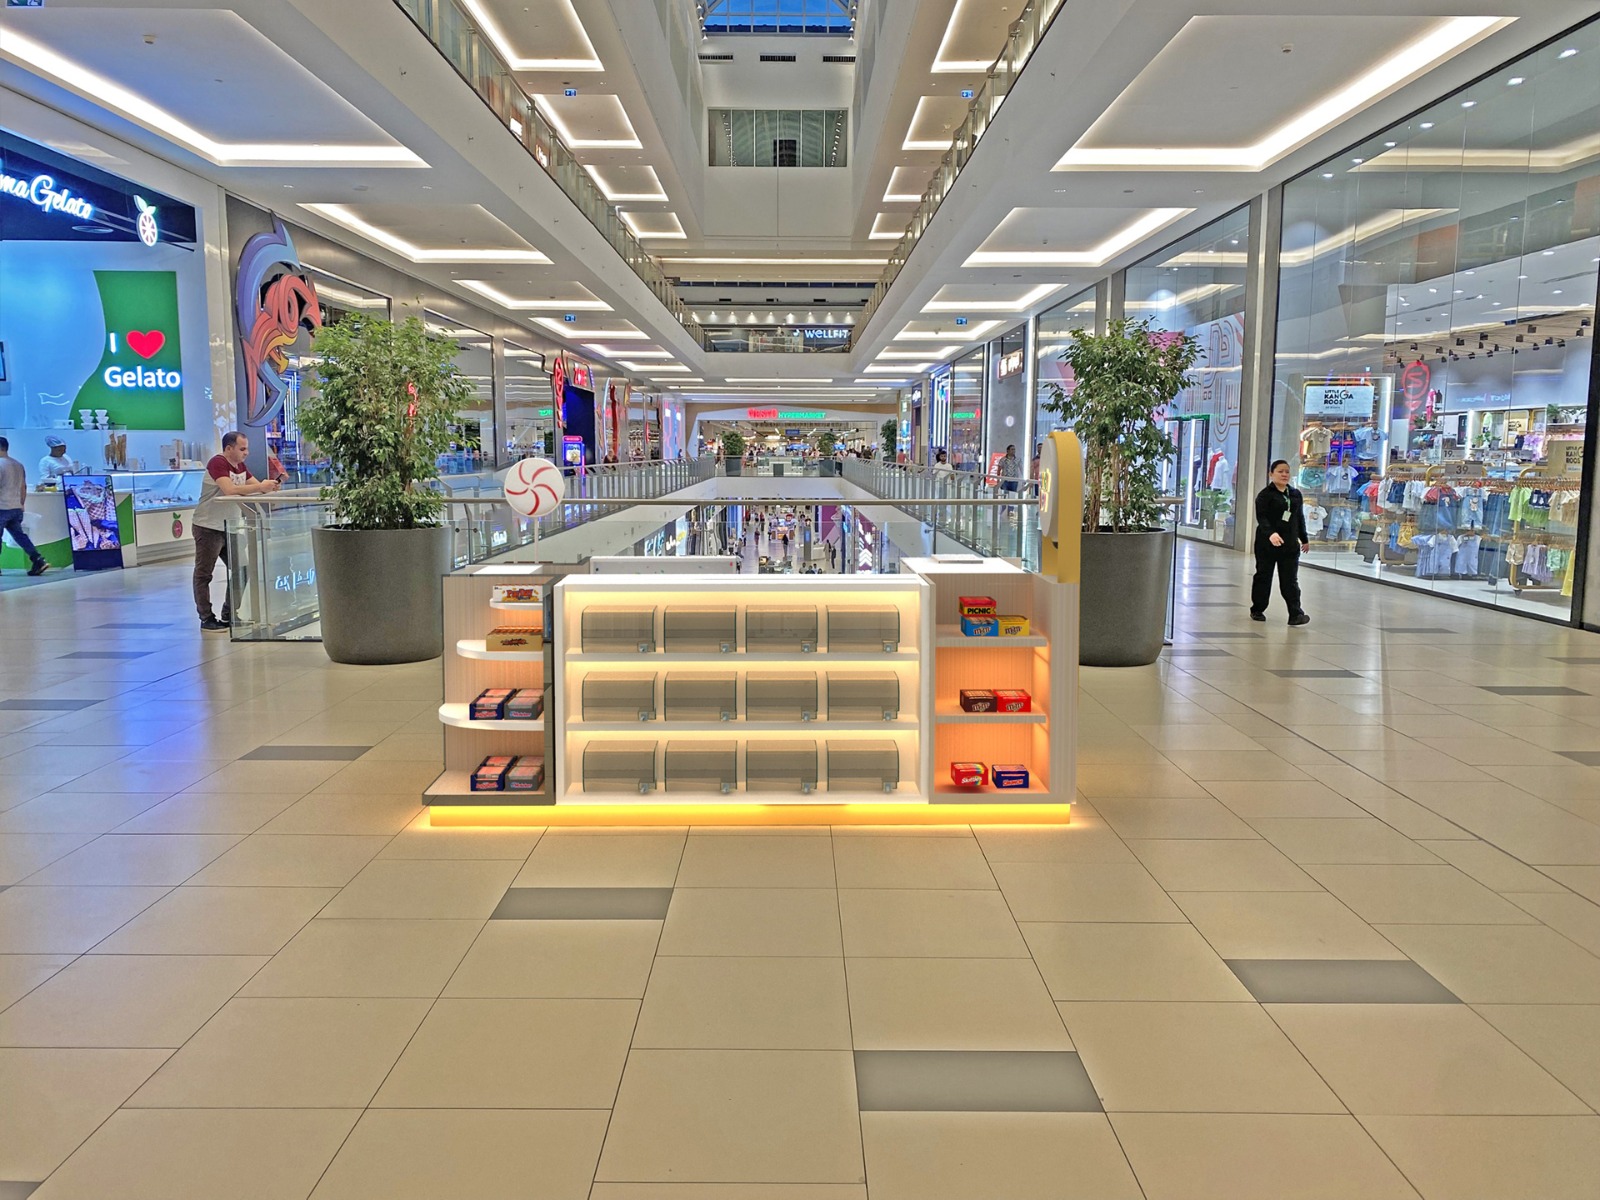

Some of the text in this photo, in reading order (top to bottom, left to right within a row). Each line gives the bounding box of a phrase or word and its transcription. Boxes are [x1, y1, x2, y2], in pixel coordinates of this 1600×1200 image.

[30, 174, 93, 219] Gelato
[109, 332, 117, 354] I
[104, 365, 181, 388] Gelato
